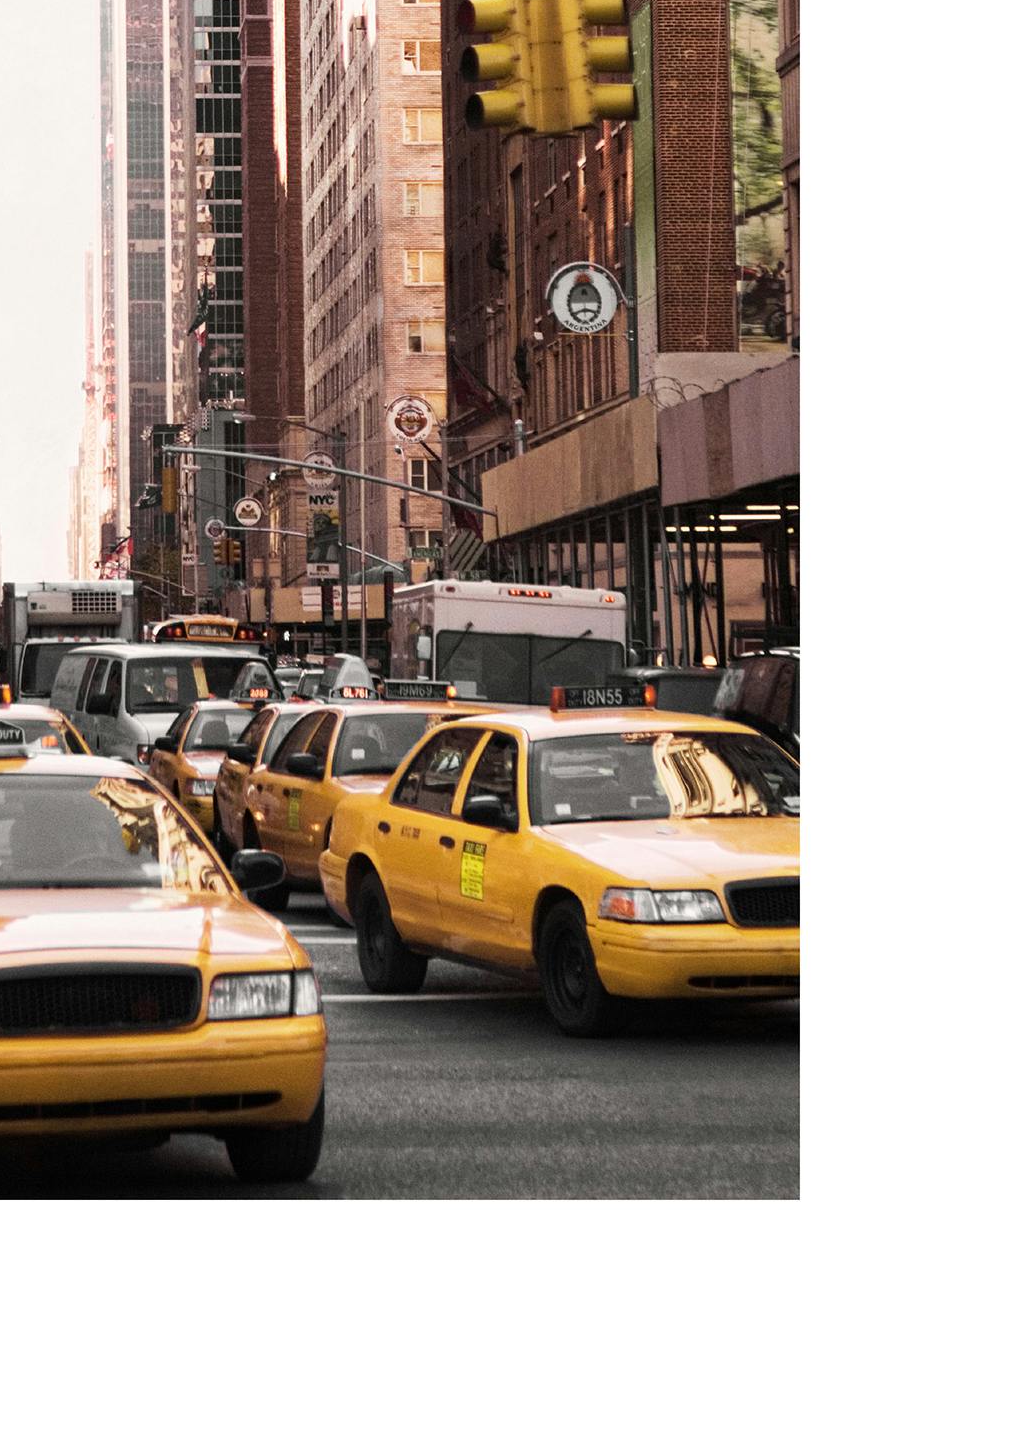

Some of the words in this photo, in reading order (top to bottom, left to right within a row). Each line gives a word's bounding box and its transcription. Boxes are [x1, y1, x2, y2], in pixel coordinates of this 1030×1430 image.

[564, 319, 607, 332] ARGENTINA
[309, 493, 335, 505] NYC
[583, 689, 623, 705] 18N55
